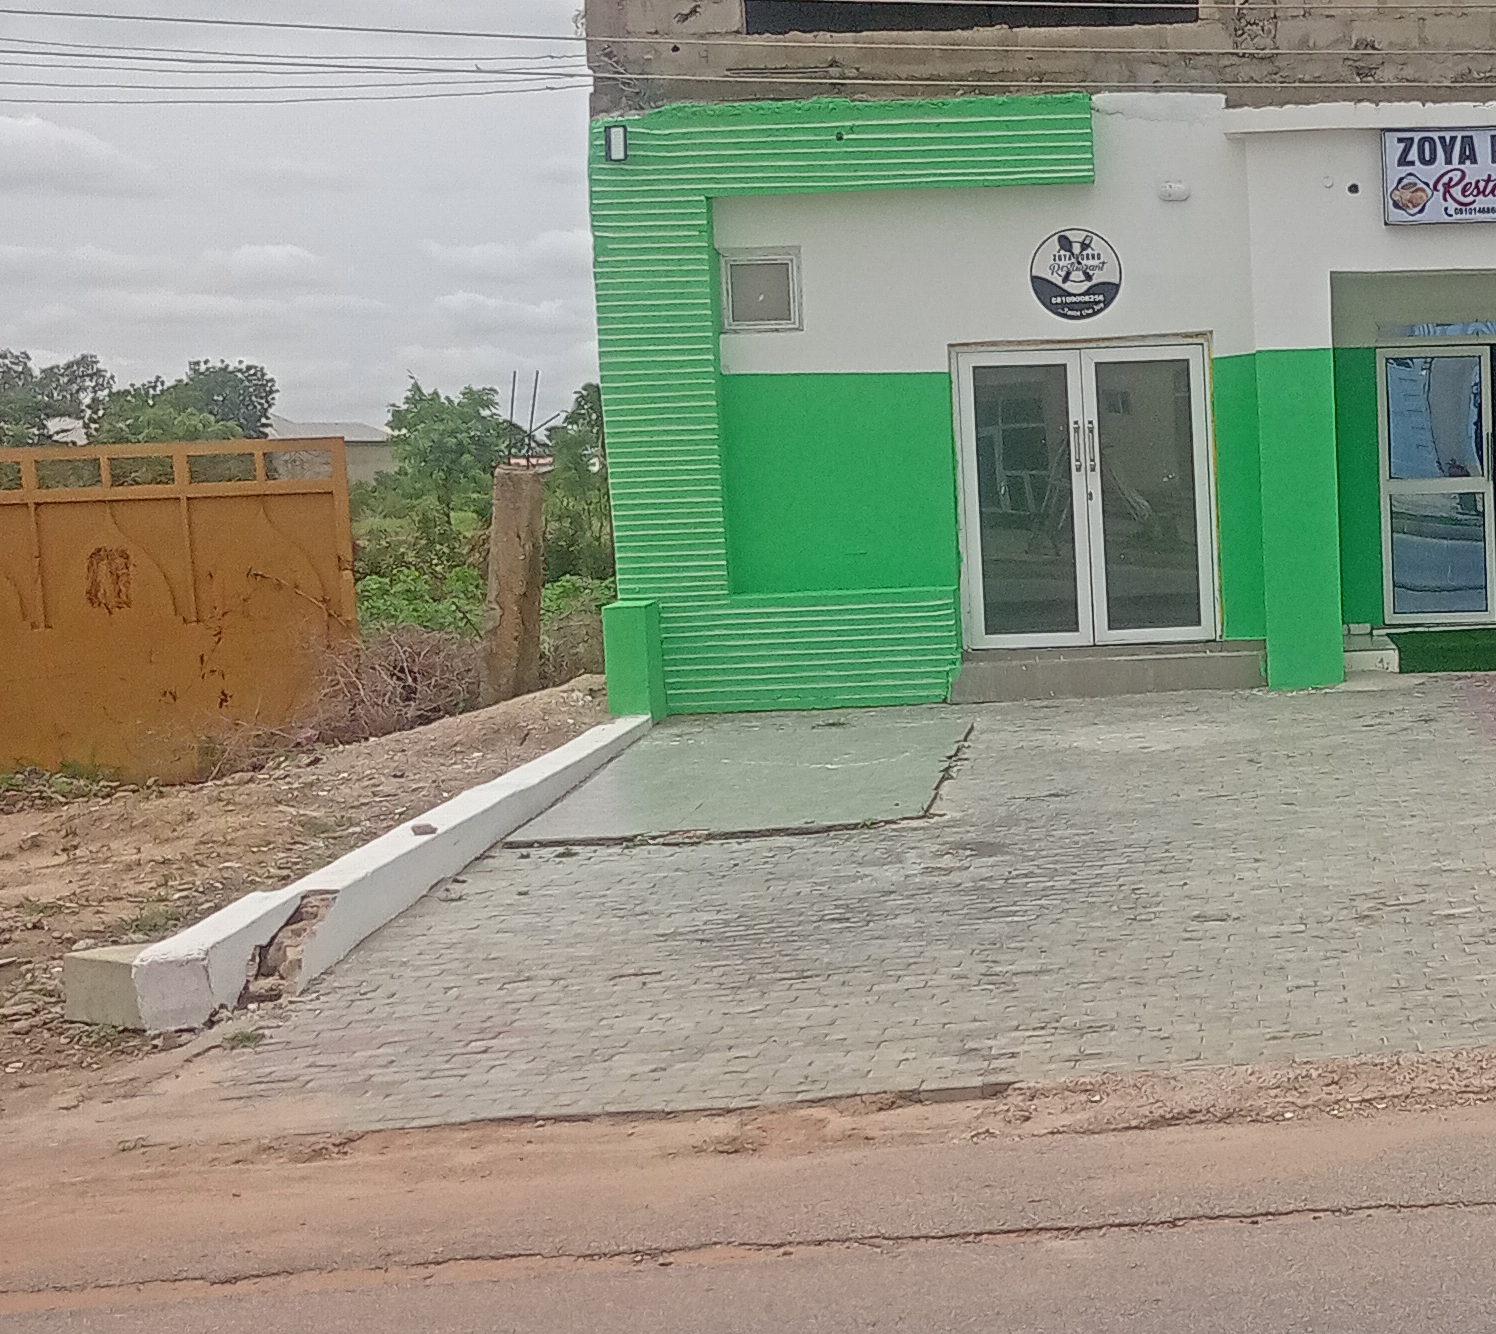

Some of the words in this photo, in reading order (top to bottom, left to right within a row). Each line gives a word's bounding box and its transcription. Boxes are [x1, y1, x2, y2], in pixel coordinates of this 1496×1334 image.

[1396, 134, 1478, 168] ZOYA
[1053, 254, 1072, 262] ZOYA
[1076, 253, 1101, 261] ORNO
